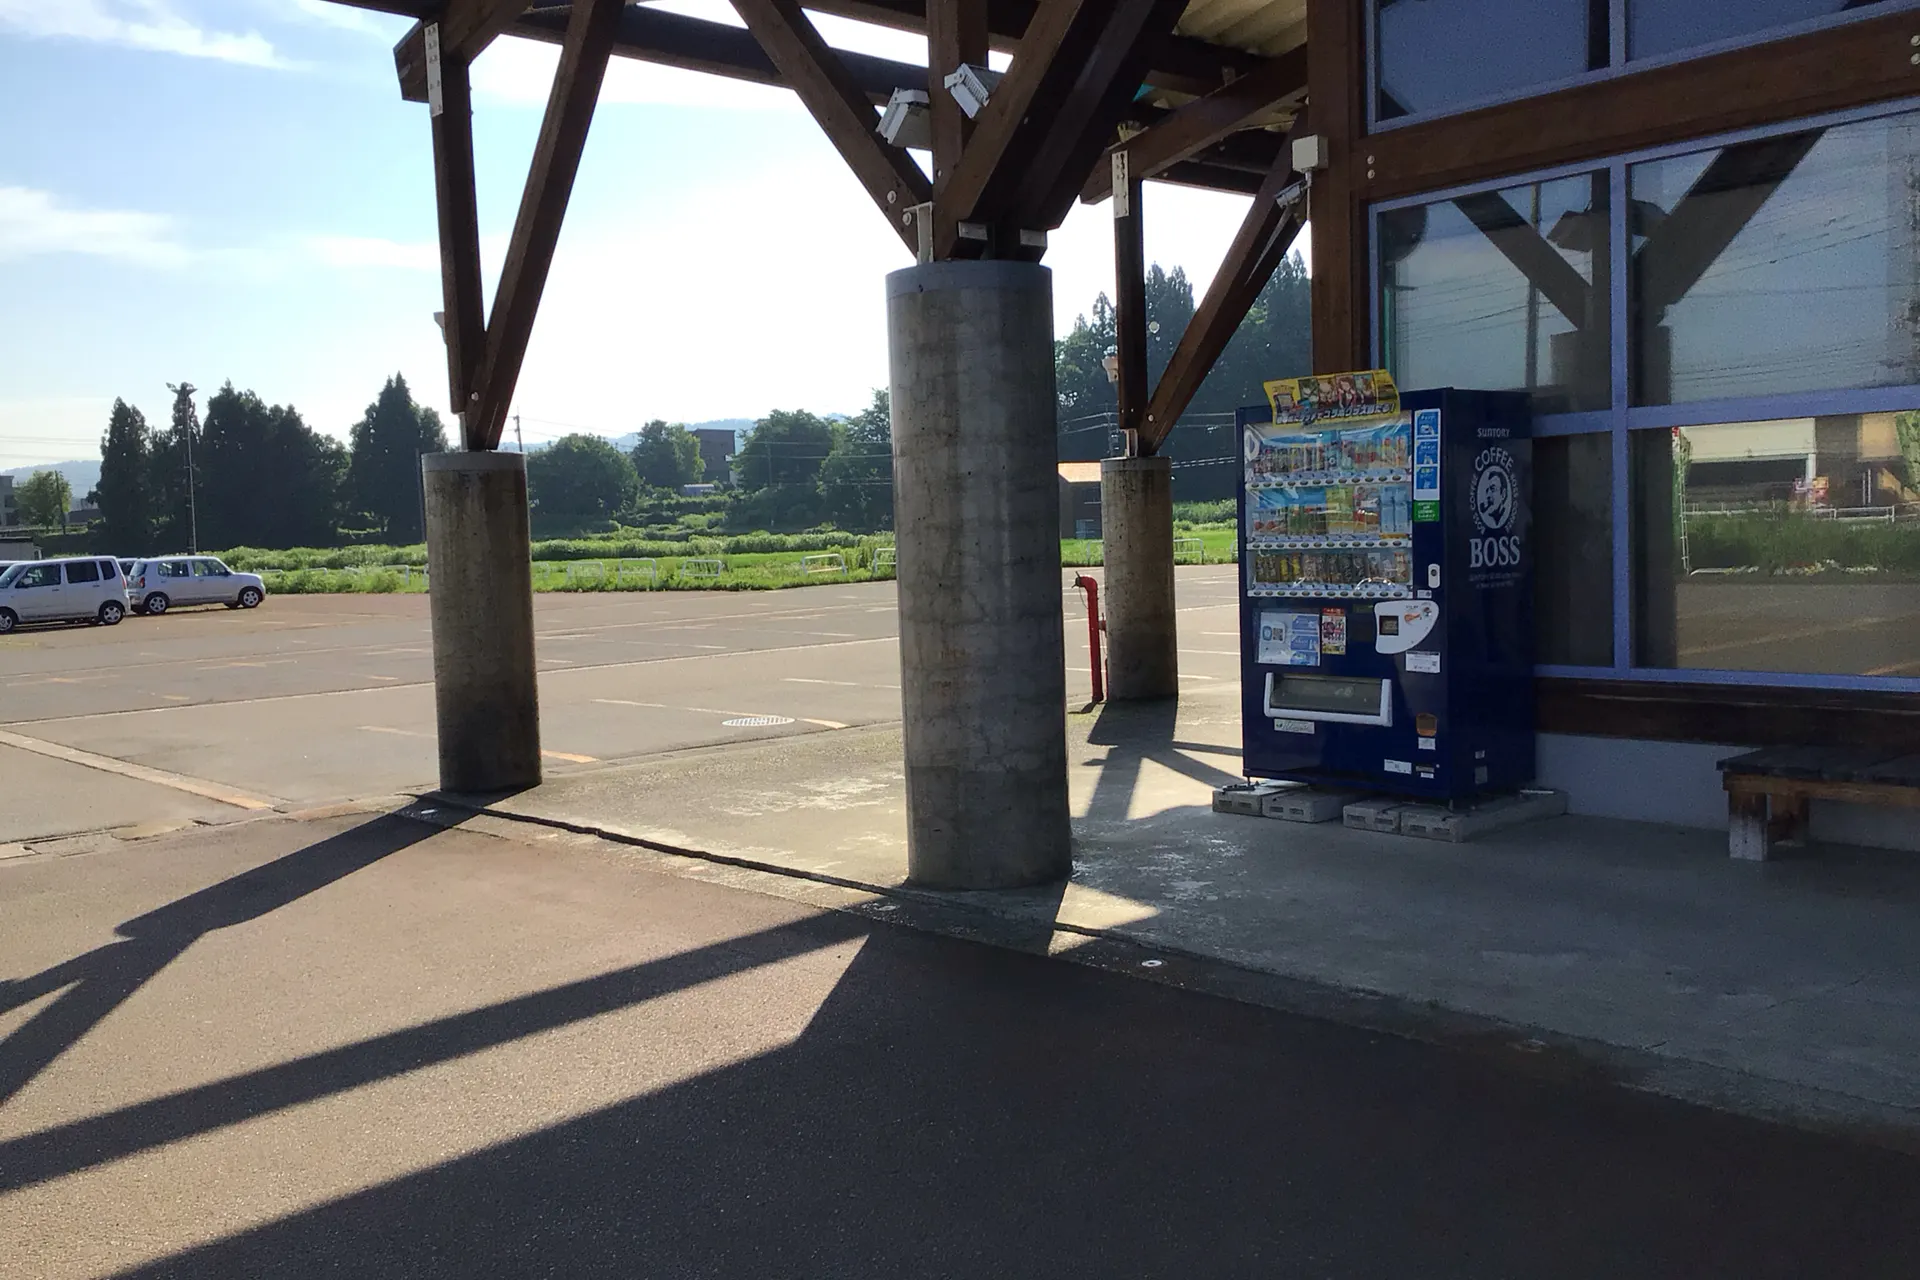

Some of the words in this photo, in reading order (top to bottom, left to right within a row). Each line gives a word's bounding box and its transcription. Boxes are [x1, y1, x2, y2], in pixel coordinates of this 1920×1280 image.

[1477, 427, 1510, 438] SUNTORY
[1475, 447, 1514, 472] COFFEE
[1469, 536, 1520, 567] BOSS
